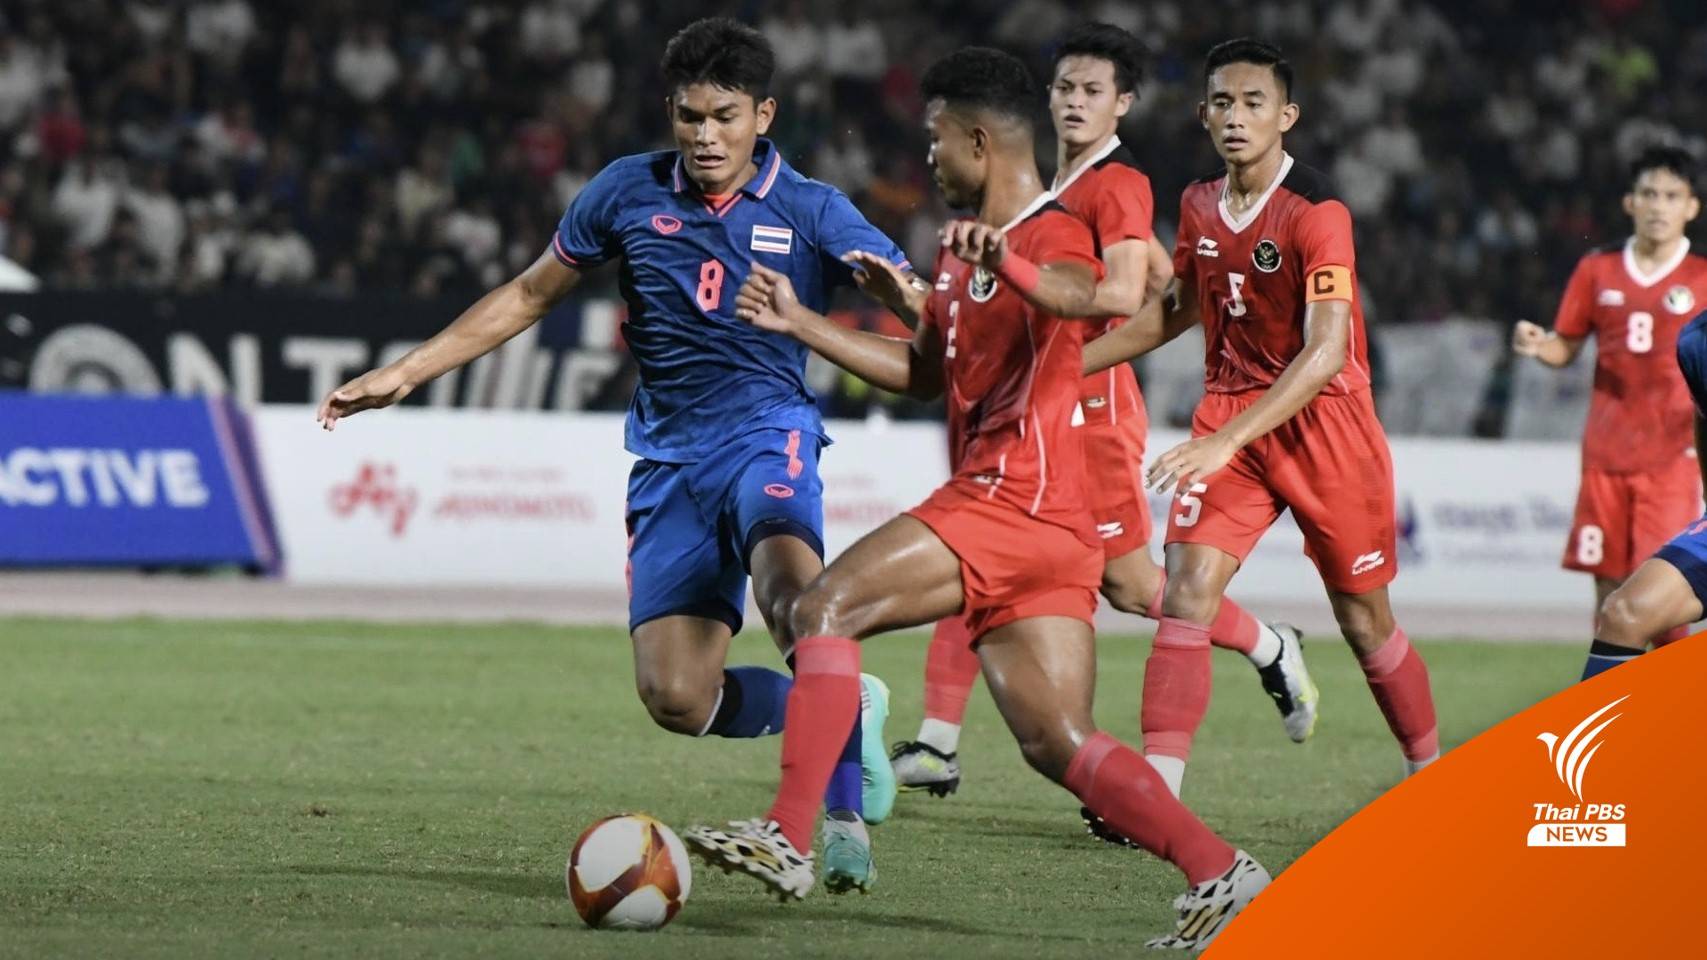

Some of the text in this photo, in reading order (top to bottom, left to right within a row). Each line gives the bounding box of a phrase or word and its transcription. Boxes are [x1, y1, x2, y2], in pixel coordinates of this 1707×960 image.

[697, 259, 724, 312] 8
[1314, 270, 1334, 294] C
[1627, 311, 1653, 353] 8
[1175, 483, 1208, 527] 5
[1578, 525, 1603, 565] 8
